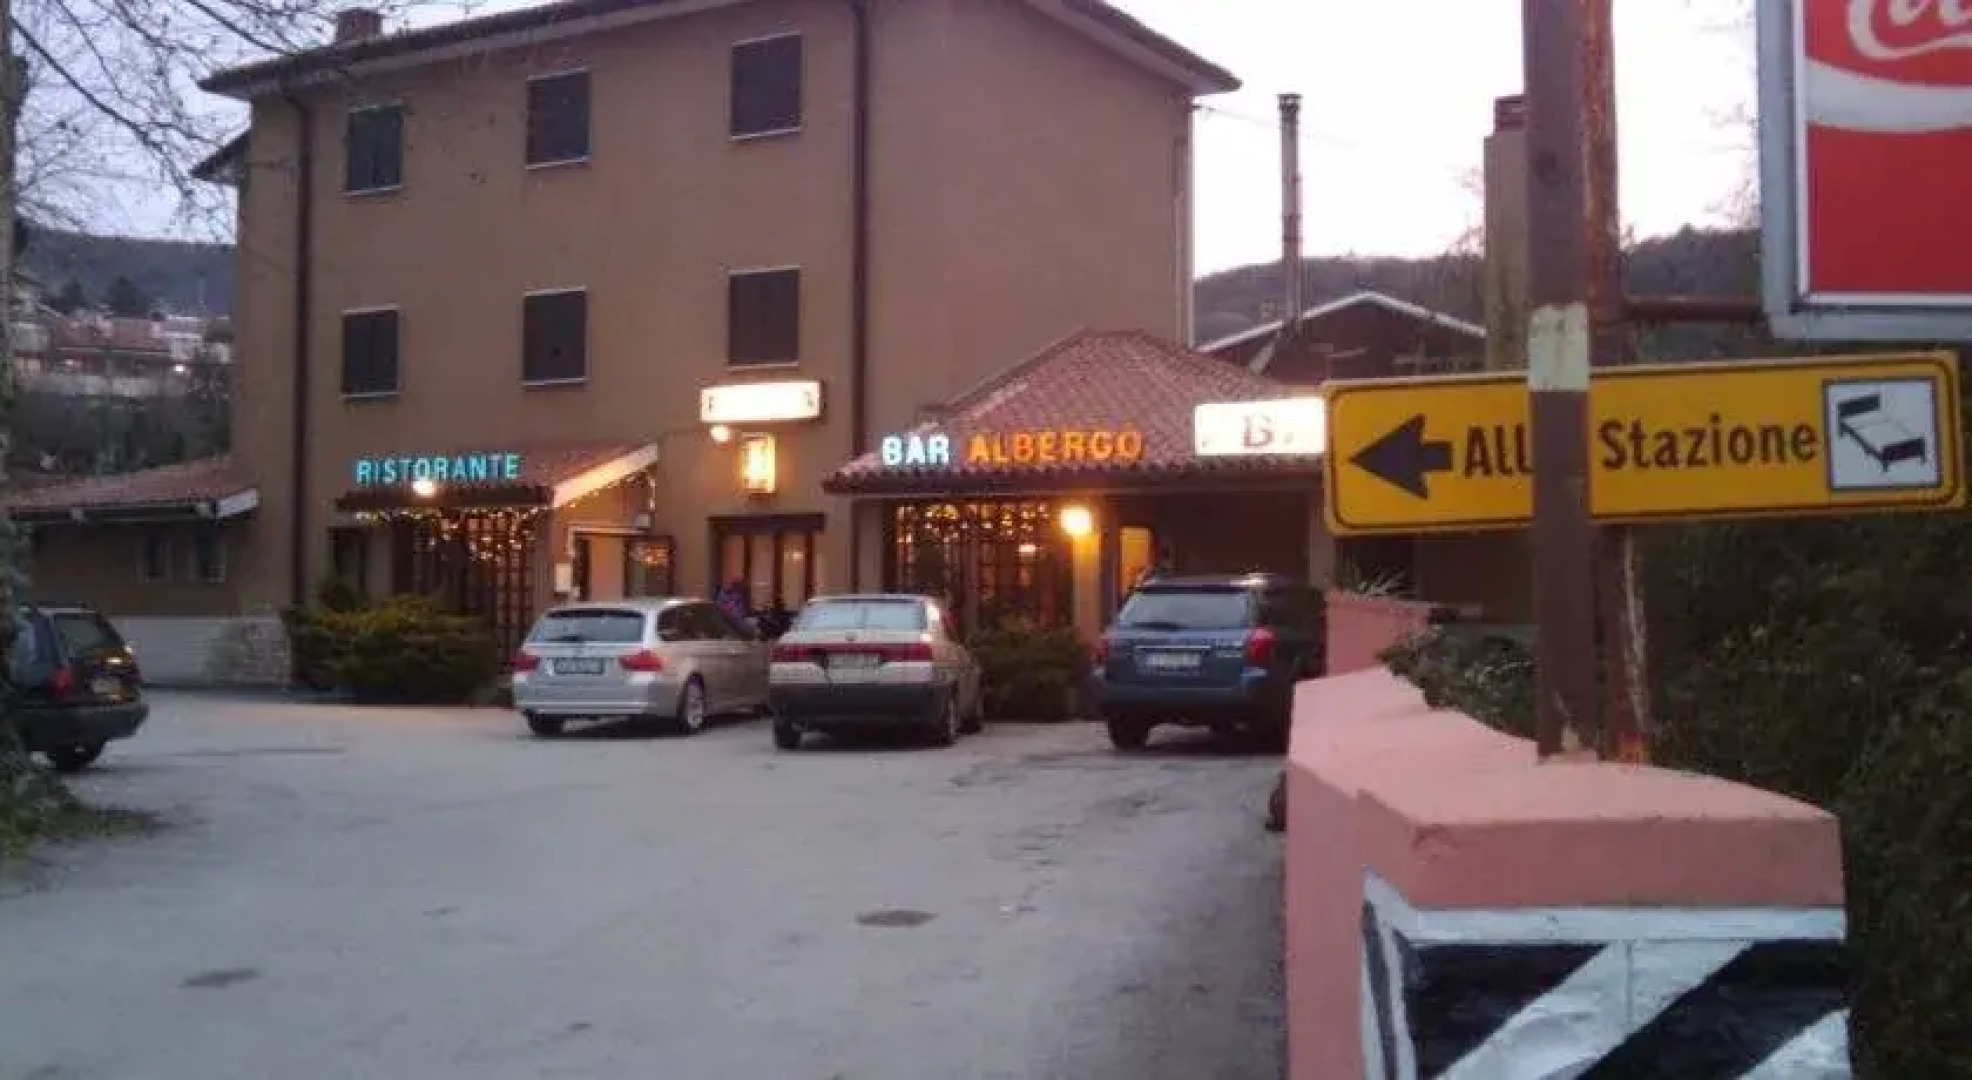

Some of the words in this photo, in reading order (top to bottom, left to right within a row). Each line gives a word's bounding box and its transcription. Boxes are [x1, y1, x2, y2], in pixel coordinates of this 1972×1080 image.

[882, 434, 950, 466] BAR
[967, 429, 1142, 464] ALBERGO
[1464, 422, 1536, 477] All
[1598, 413, 1817, 470] Stazione
[356, 451, 520, 486] RISTORANTE
